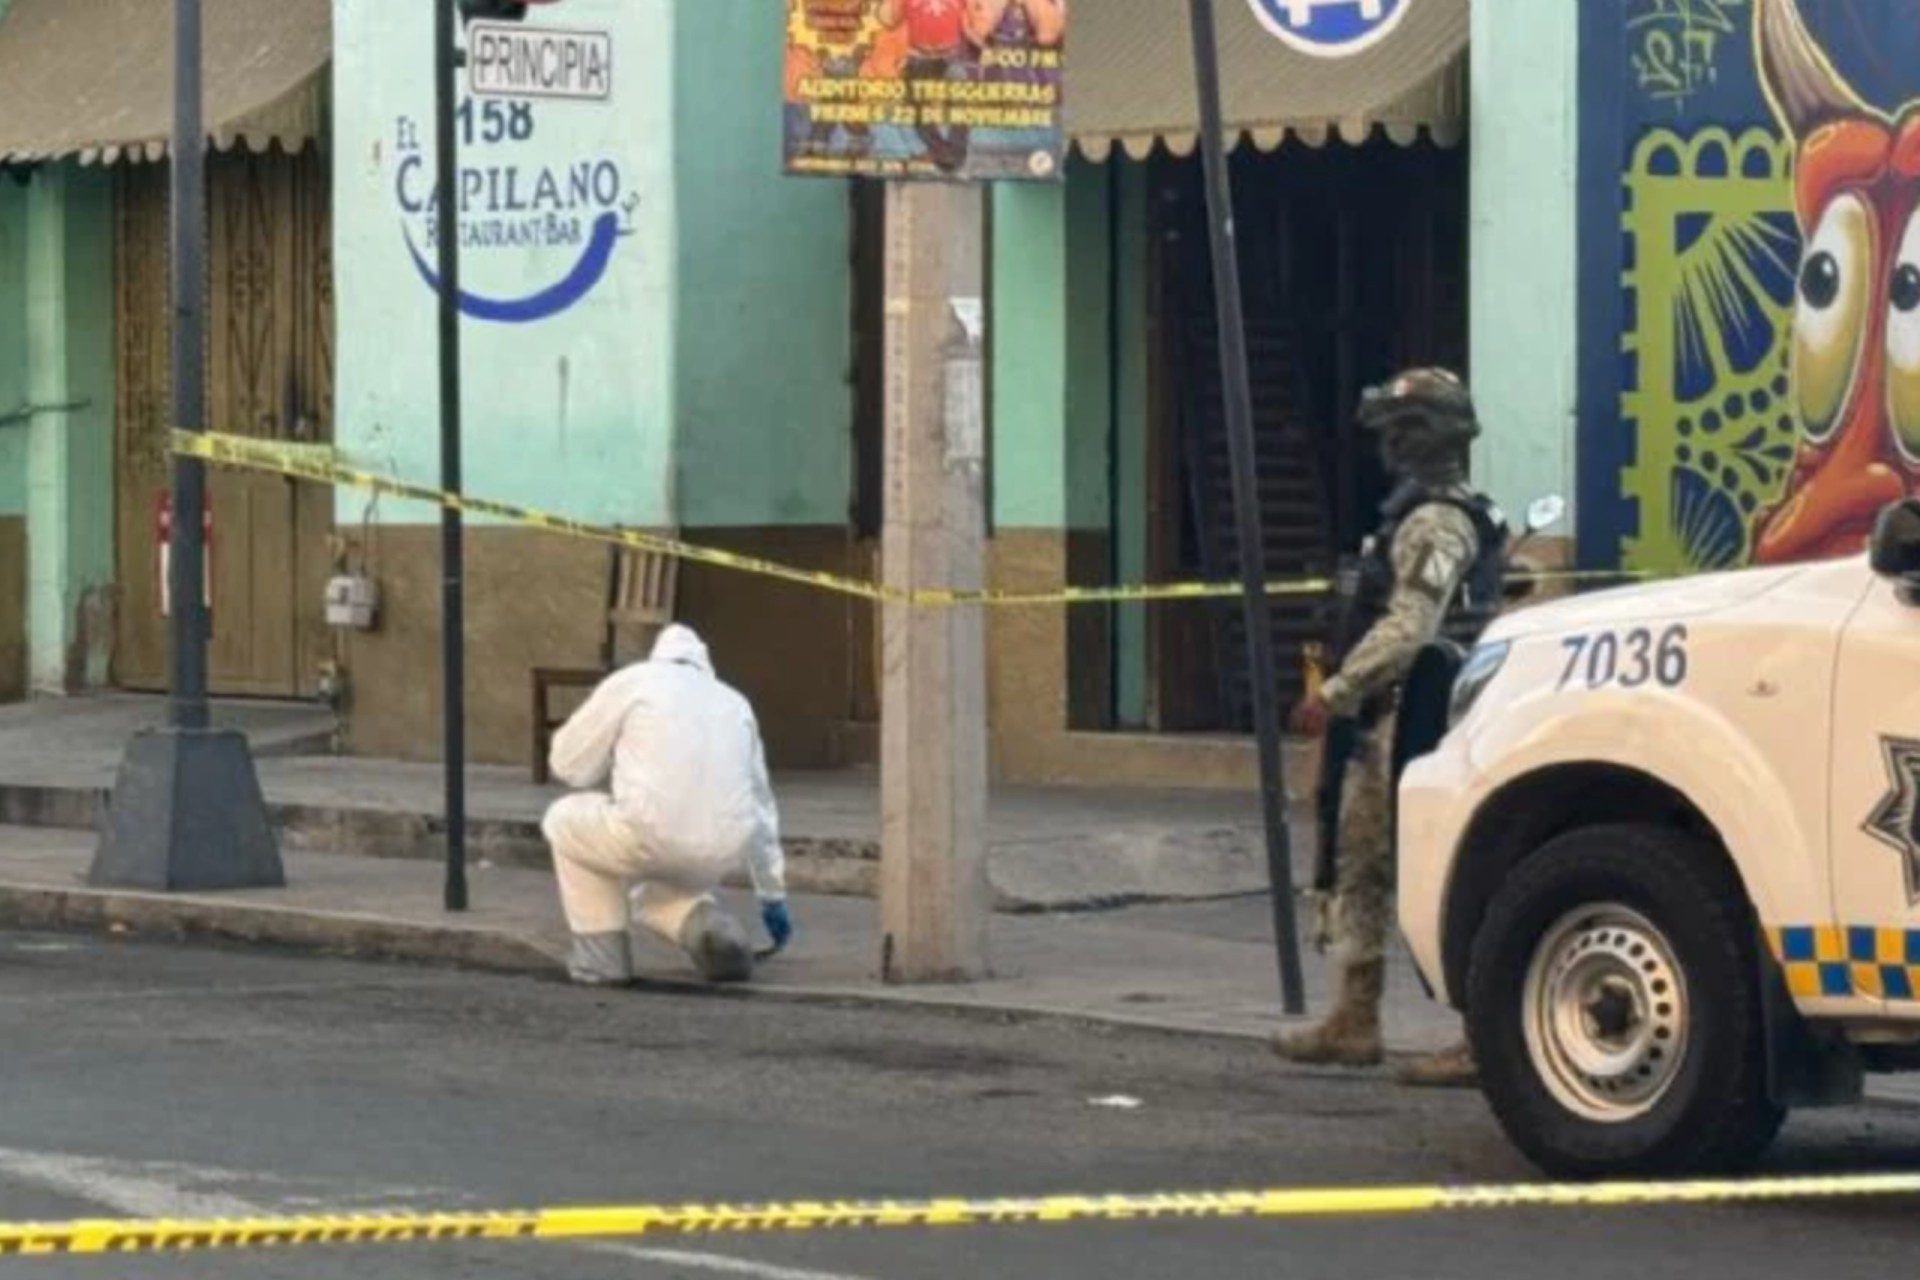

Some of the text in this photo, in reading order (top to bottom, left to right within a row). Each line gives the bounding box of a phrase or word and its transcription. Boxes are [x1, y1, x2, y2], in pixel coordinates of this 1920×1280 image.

[479, 34, 604, 89] PRINCIPIA
[397, 115, 420, 151] EL
[456, 97, 533, 146] 158
[1554, 623, 1688, 692] 7036
